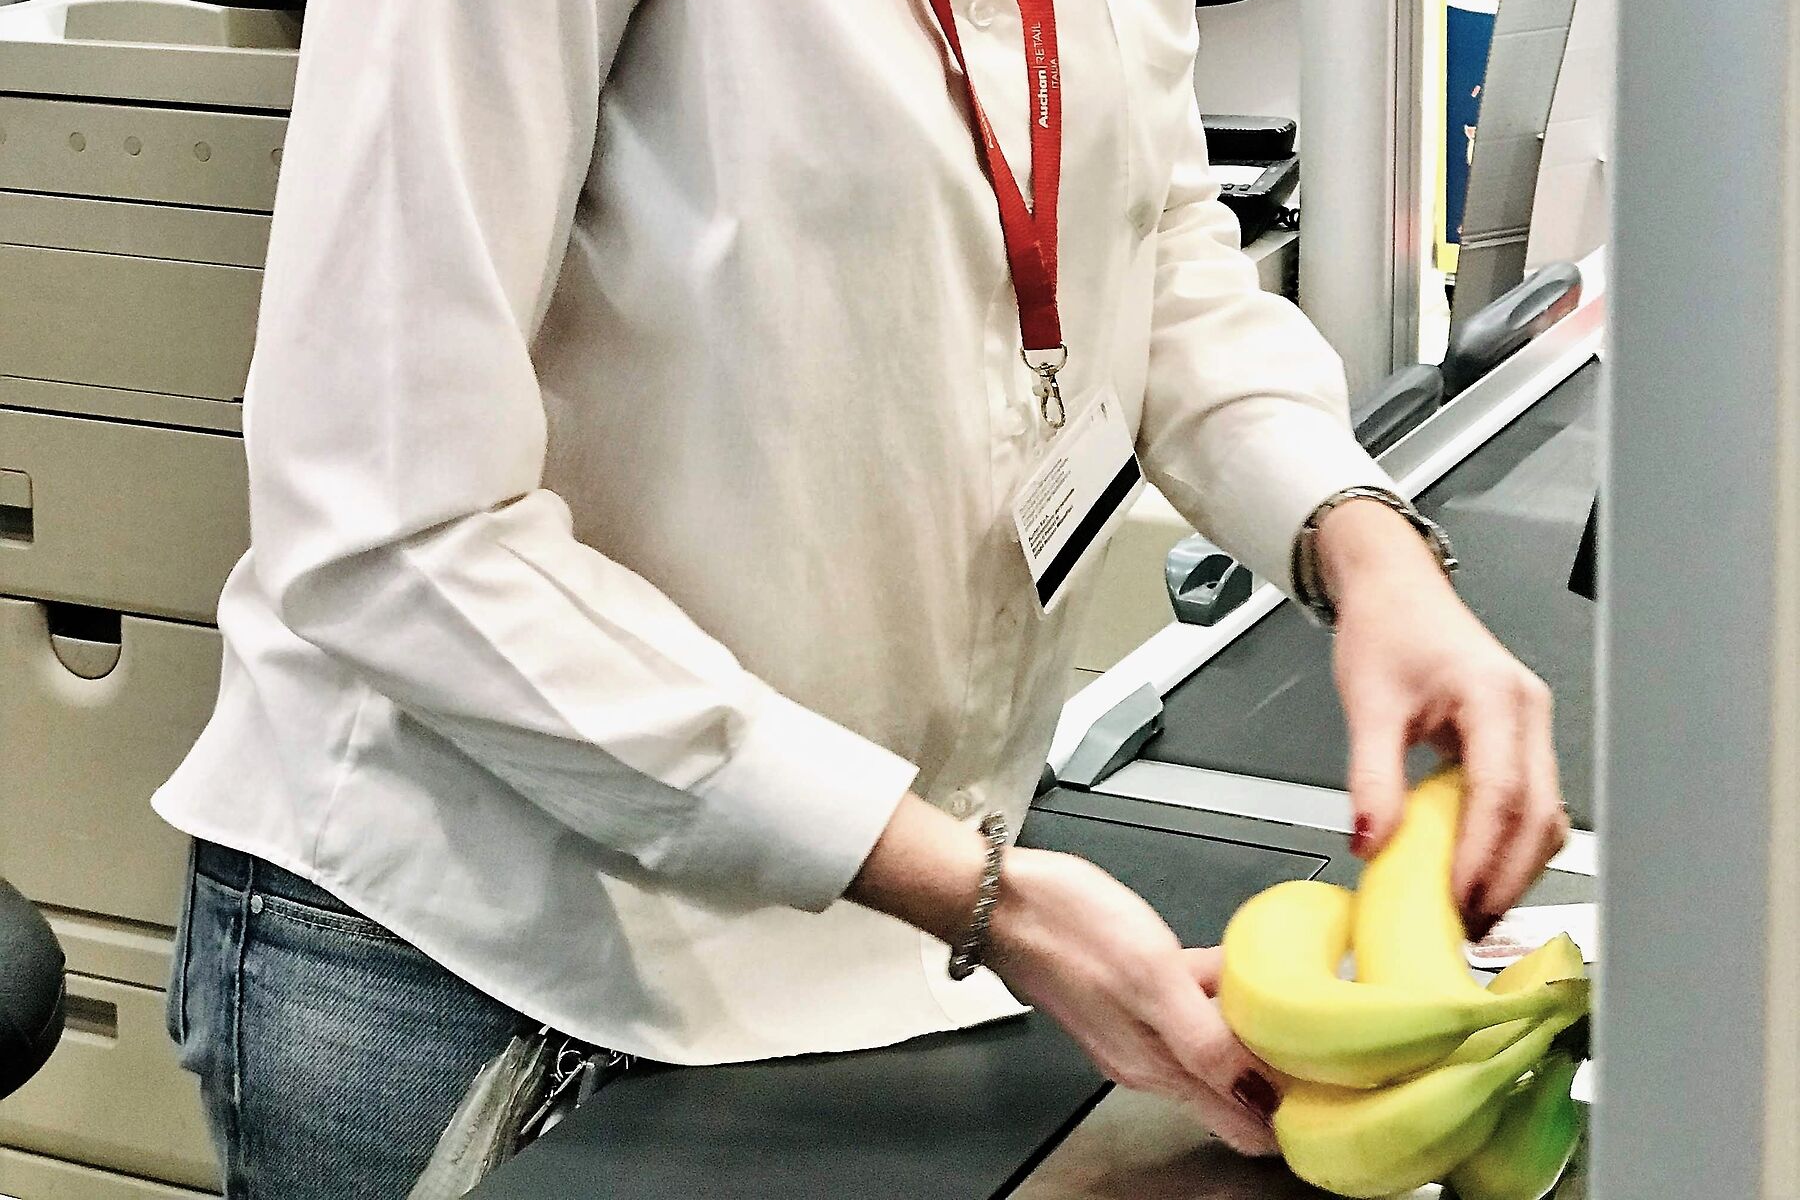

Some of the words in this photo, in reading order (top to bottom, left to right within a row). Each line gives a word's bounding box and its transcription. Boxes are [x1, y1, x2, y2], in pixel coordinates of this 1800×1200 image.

[1031, 21, 1045, 64] RETAIL
[1050, 58, 1060, 89] ITALIA
[1038, 69, 1049, 128] Auchan
